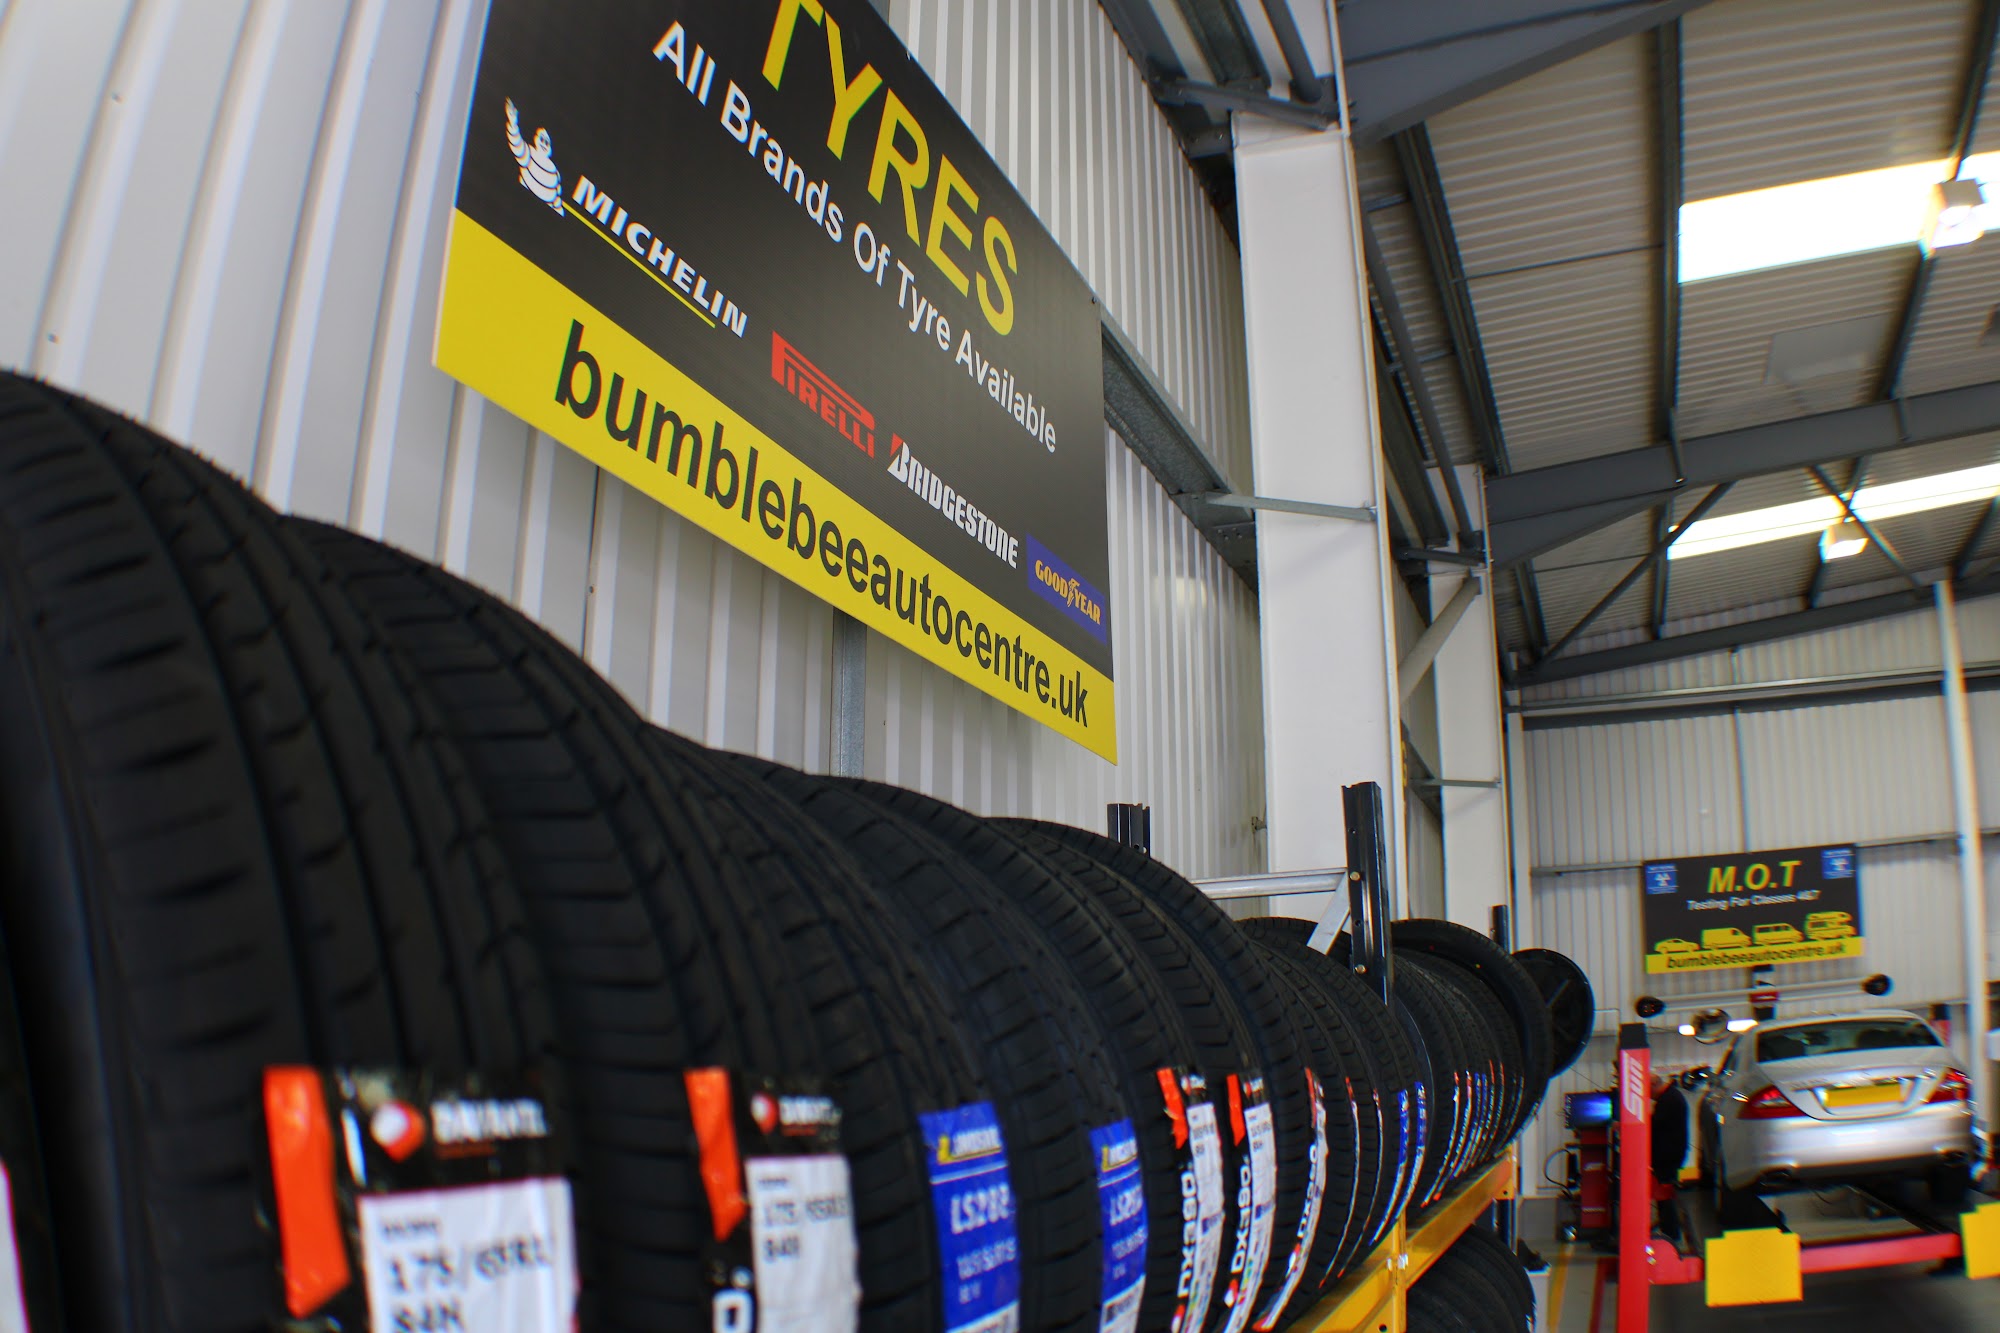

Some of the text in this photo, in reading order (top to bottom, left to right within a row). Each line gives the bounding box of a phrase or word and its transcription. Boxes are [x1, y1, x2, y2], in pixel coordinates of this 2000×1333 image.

[763, 0, 1018, 336] TYRES
[572, 175, 748, 338] MICHELIN
[653, 21, 1057, 453] All Brands Of Tyre Available
[771, 330, 876, 459] PIRELLI
[554, 318, 1089, 728] bumblebeeautocentre.uk
[887, 432, 1019, 569] BRIDGESTONE
[1034, 559, 1102, 626] GOODYEAR
[1686, 897, 1730, 911] Testing
[1707, 860, 1802, 894] M.O.T
[1666, 943, 1847, 969] bumblebeeautocentre.uk
